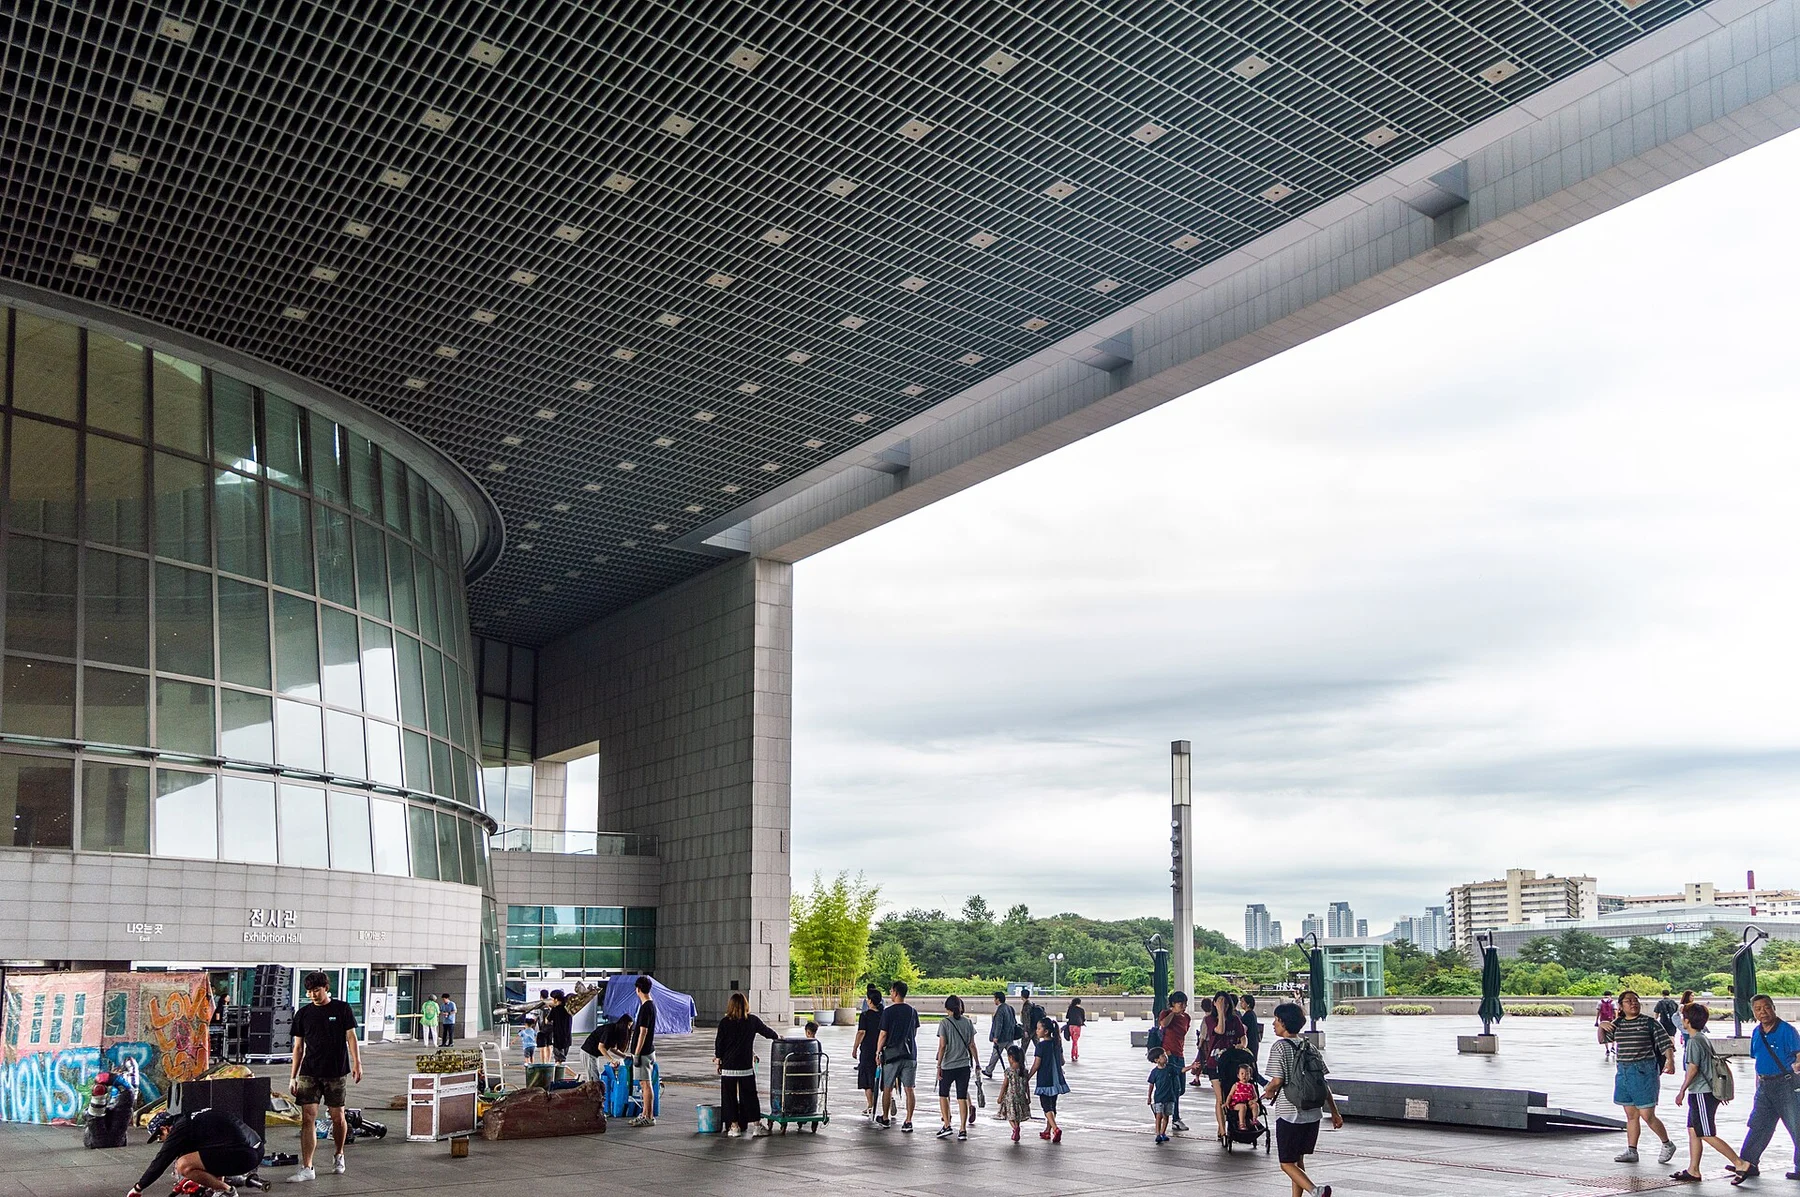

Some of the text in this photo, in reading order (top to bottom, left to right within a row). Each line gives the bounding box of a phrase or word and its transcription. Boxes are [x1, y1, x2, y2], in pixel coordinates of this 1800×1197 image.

[249, 908, 298, 928] 전시관
[126, 923, 163, 935] 나오는 곳
[243, 931, 302, 943] Exhibition Hall
